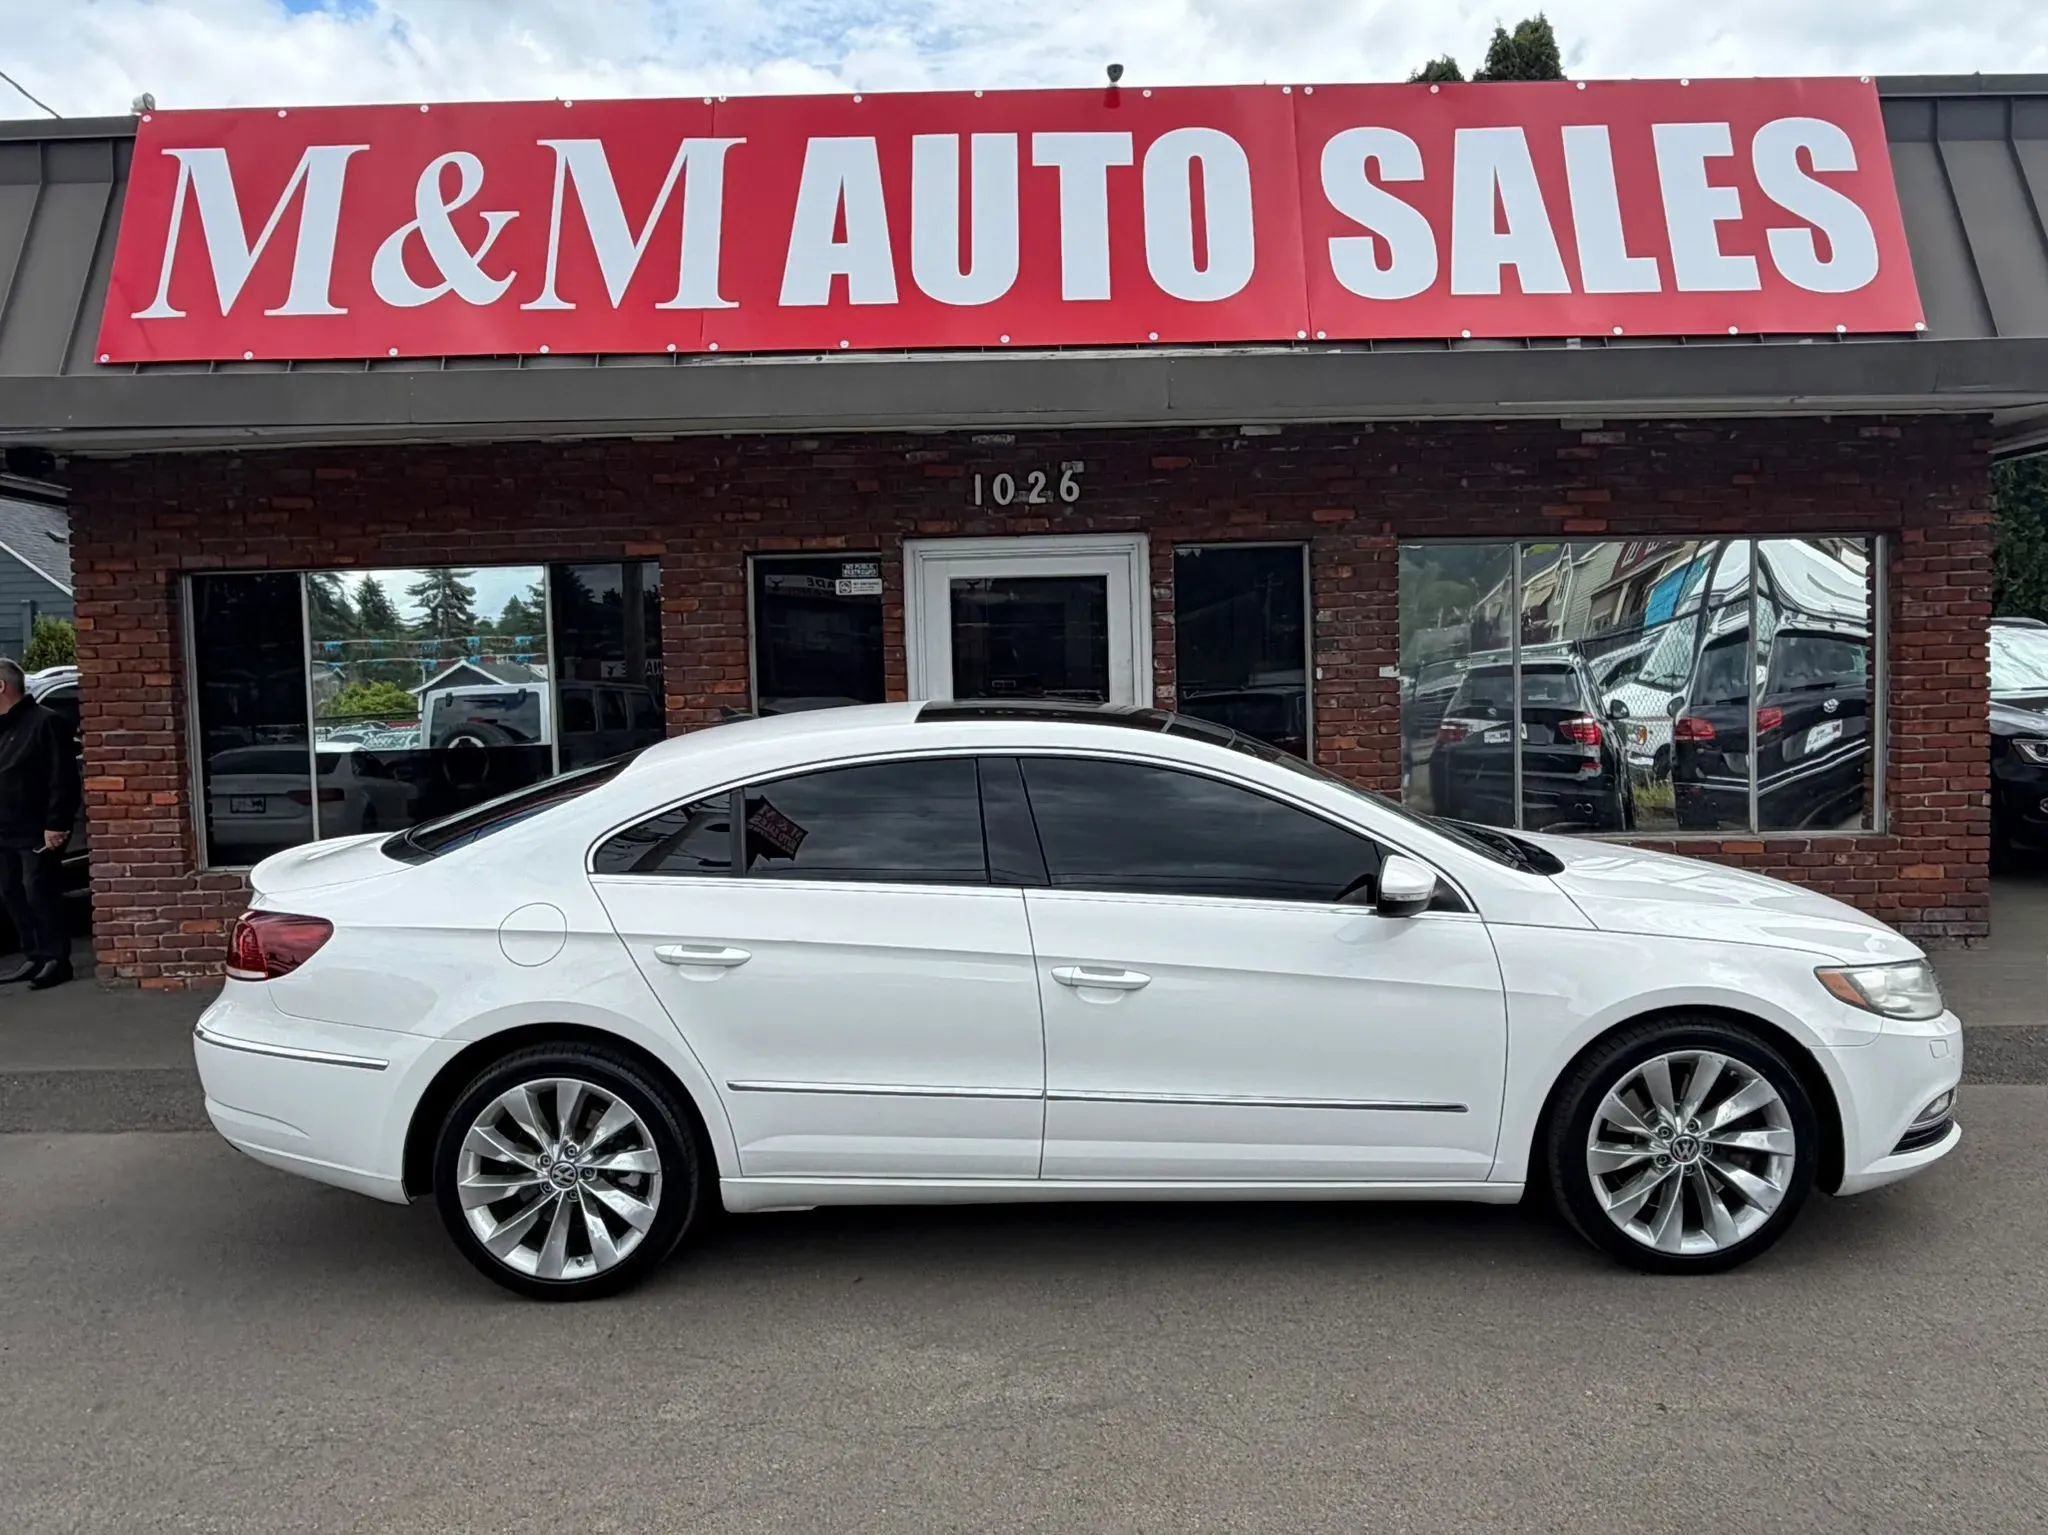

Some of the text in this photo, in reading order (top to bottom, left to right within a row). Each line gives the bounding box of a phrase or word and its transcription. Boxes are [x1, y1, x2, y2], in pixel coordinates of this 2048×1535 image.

[778, 127, 1255, 306] AUTO
[1320, 116, 1880, 300] SALES
[974, 469, 1080, 506] 1026
